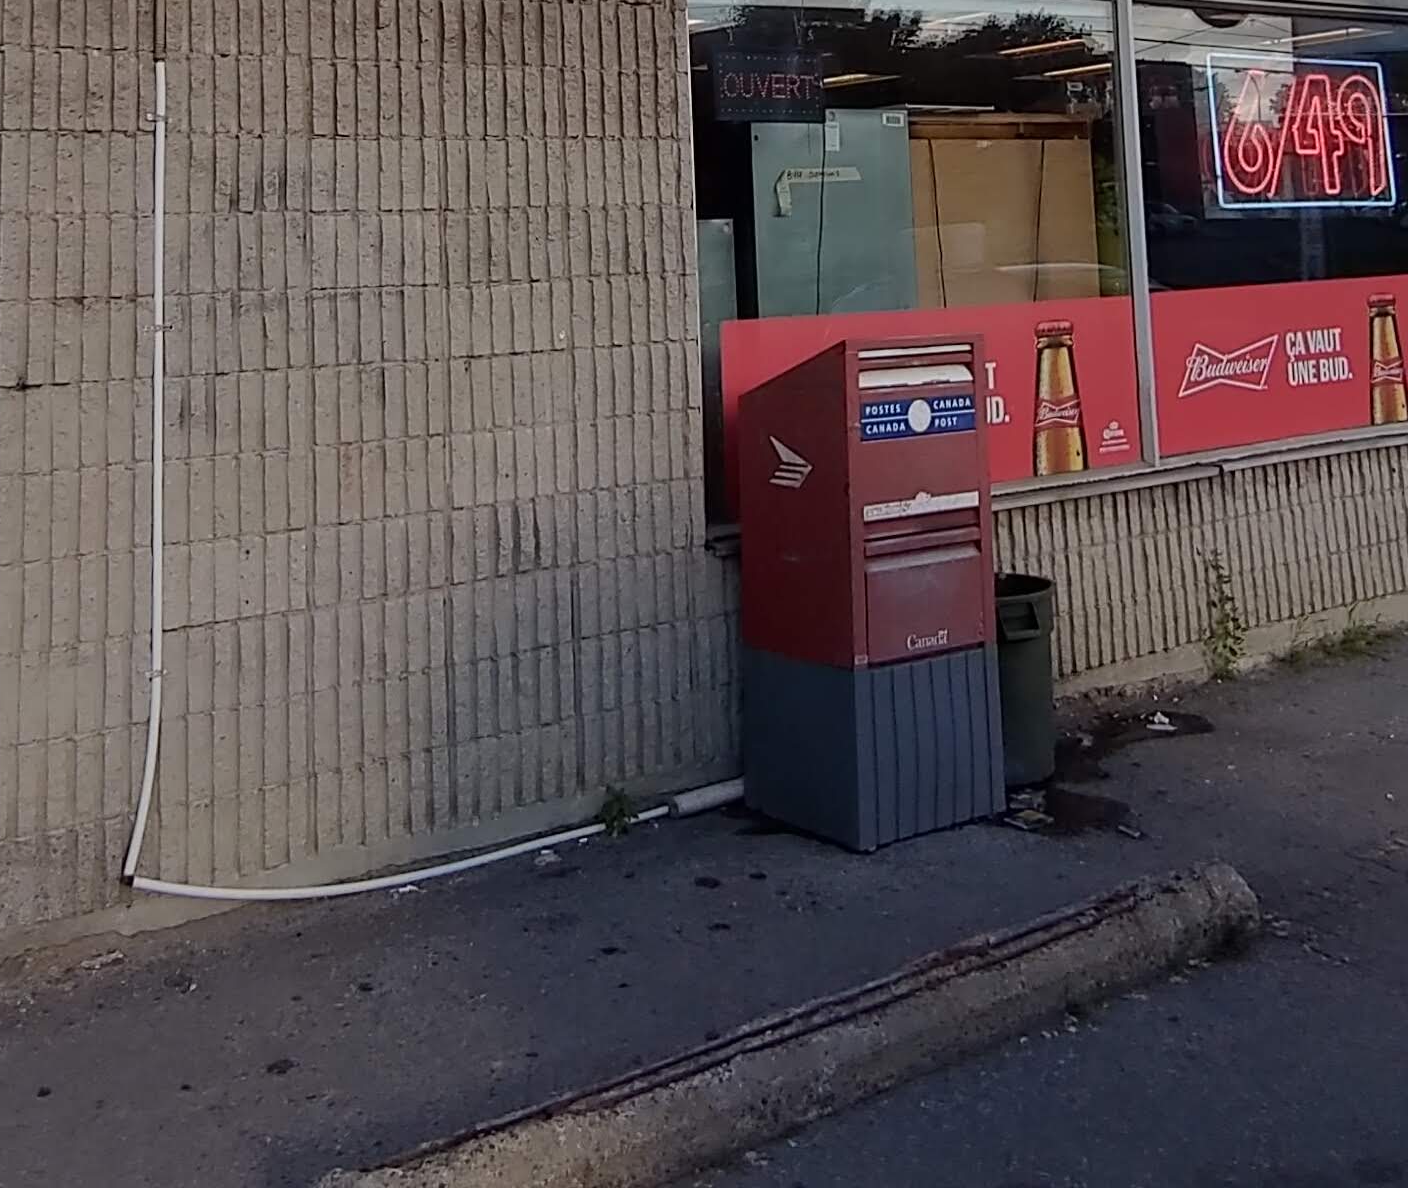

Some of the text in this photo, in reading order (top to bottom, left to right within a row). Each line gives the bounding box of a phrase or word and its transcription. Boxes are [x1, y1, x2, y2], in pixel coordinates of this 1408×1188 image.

[723, 72, 815, 100] OUVERT
[1186, 328, 1342, 382] Budweiser ÇA VAUT
[1287, 360, 1318, 387] UNE
[1319, 357, 1353, 382] BUD.
[865, 397, 972, 416] POSTES CANADA
[865, 416, 958, 435] CANADA POST
[907, 629, 948, 651] Canada
